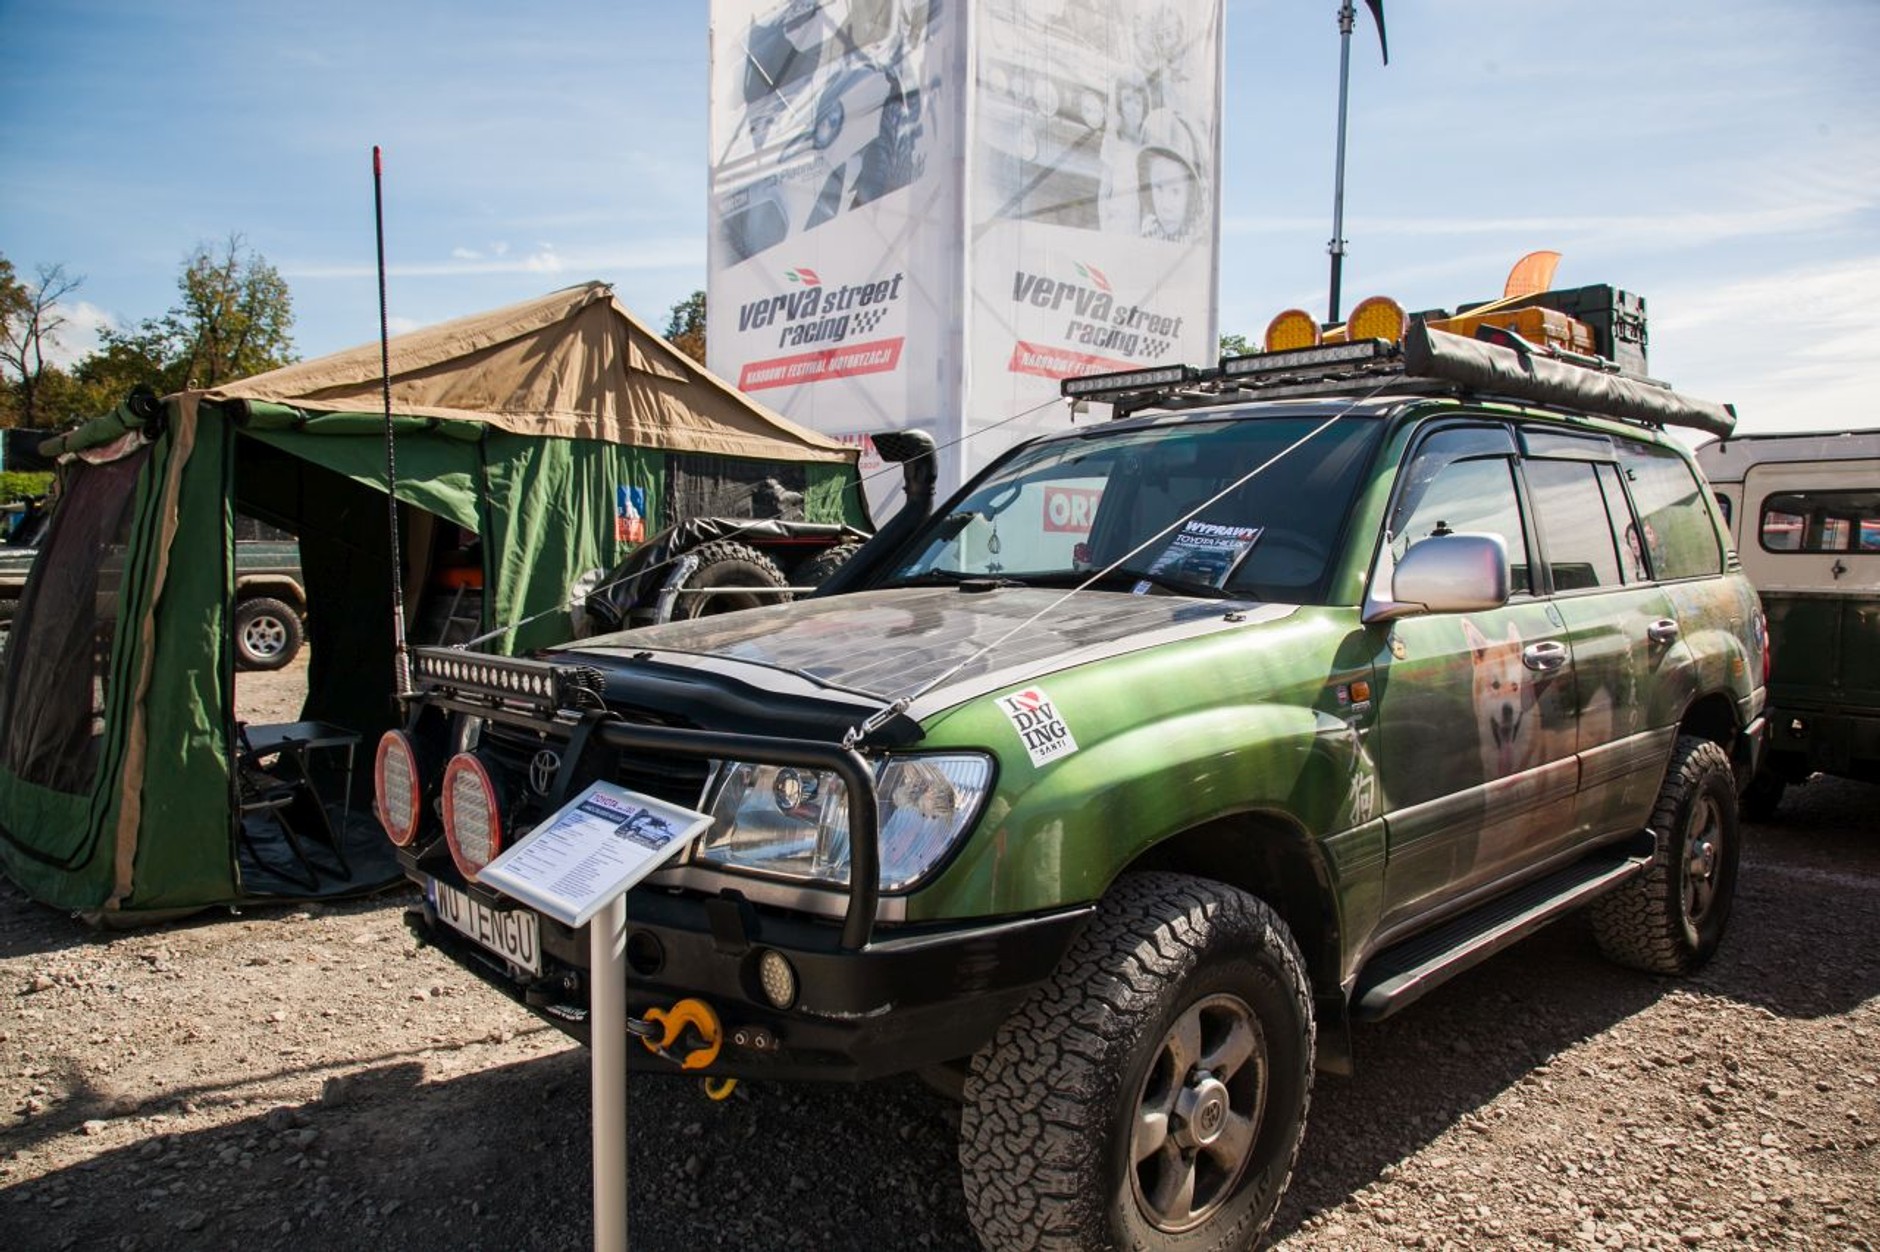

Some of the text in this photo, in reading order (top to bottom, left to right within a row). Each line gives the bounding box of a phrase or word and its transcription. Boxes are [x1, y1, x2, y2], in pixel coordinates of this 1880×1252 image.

[738, 273, 903, 332] verva street
[1012, 270, 1184, 339] verva street
[779, 316, 848, 348] racing
[1065, 320, 1139, 357] racing
[1176, 534, 1214, 547] TOYOTA
[1185, 520, 1259, 537] WYPRAWY
[1012, 702, 1054, 732] DIV
[1022, 720, 1067, 750] ING
[1039, 741, 1067, 755] SANTI
